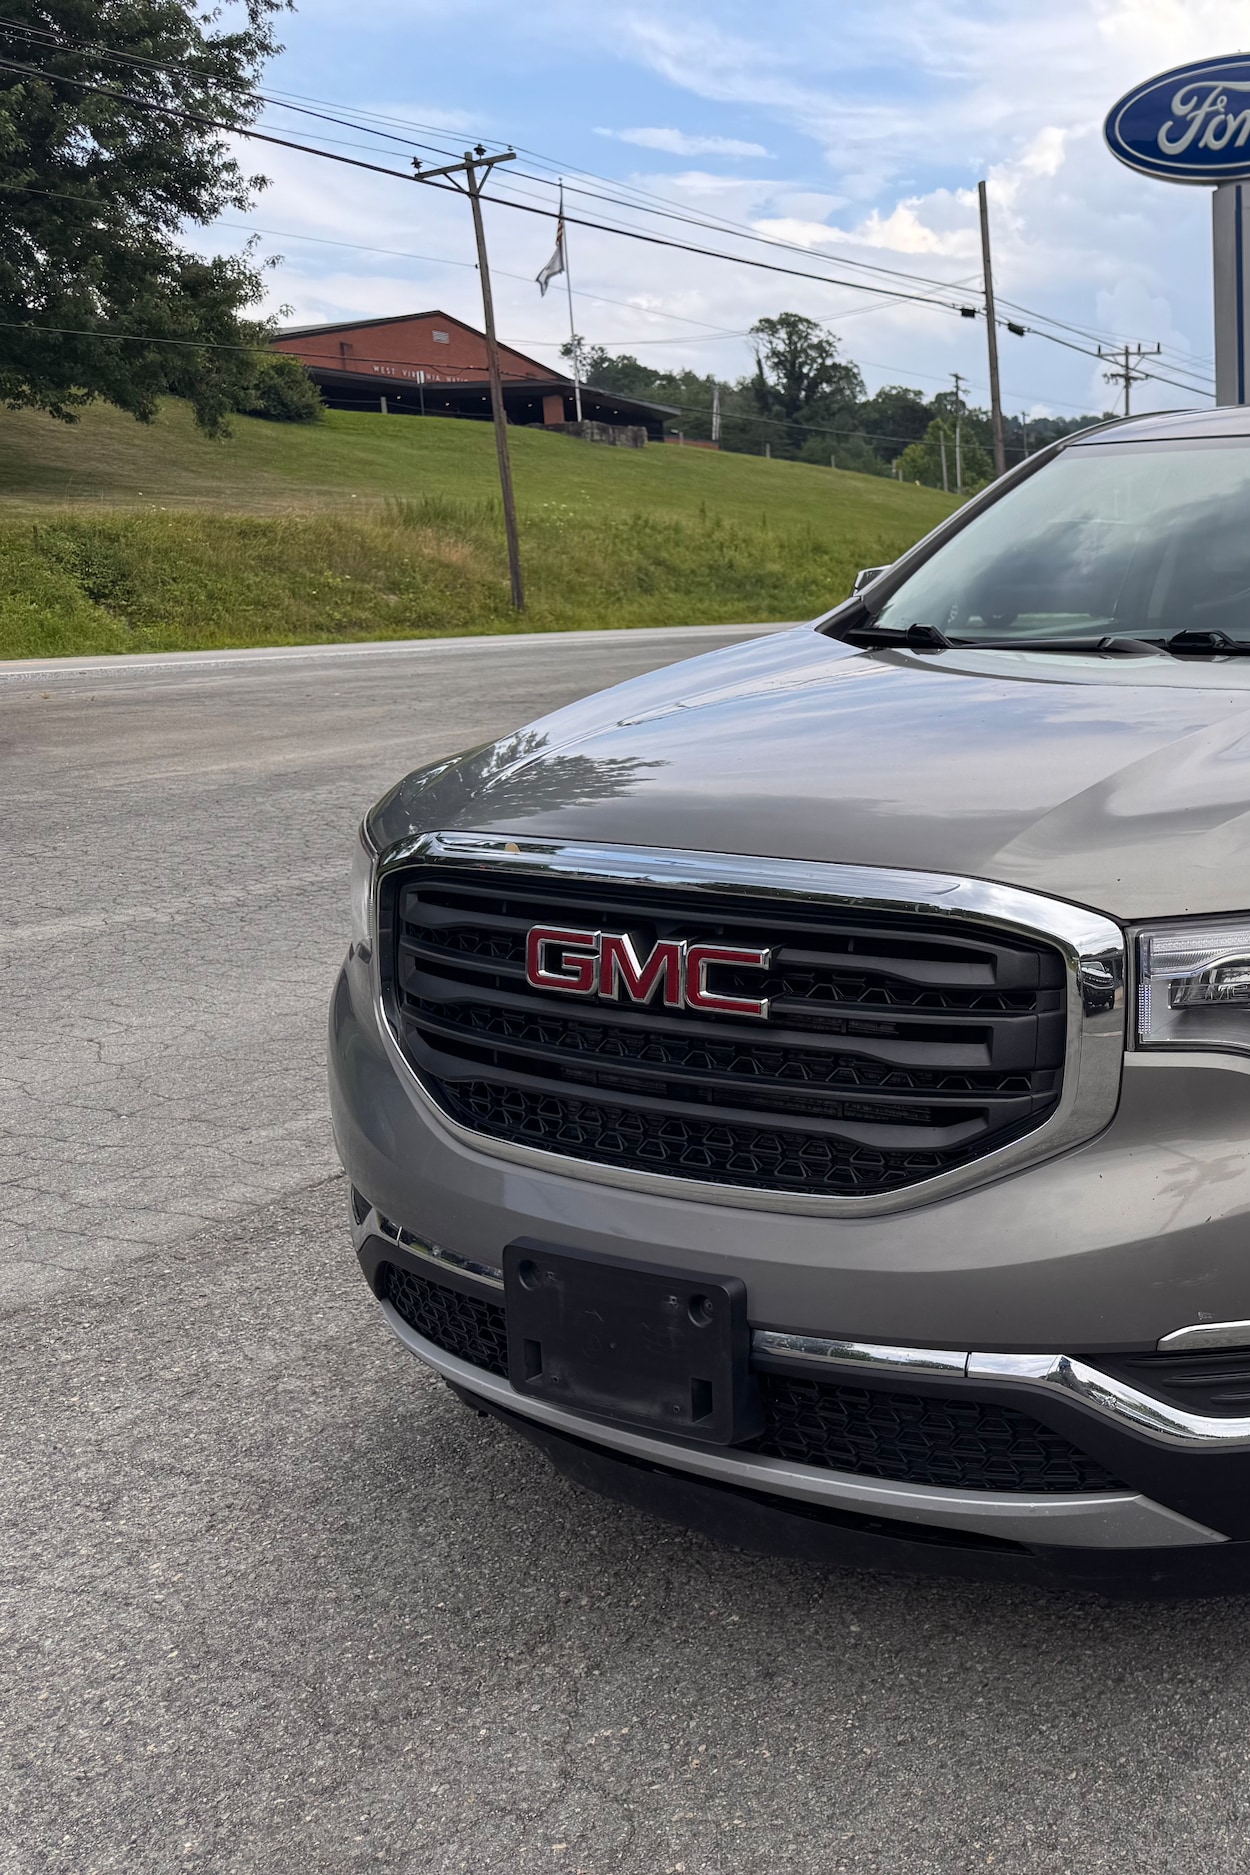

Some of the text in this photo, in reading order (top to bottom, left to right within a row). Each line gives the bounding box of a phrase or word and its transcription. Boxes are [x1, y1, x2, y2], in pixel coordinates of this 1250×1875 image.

[373, 365, 395, 375] WEST
[402, 369, 440, 381] VIRNIA
[526, 924, 770, 1020] GMC
